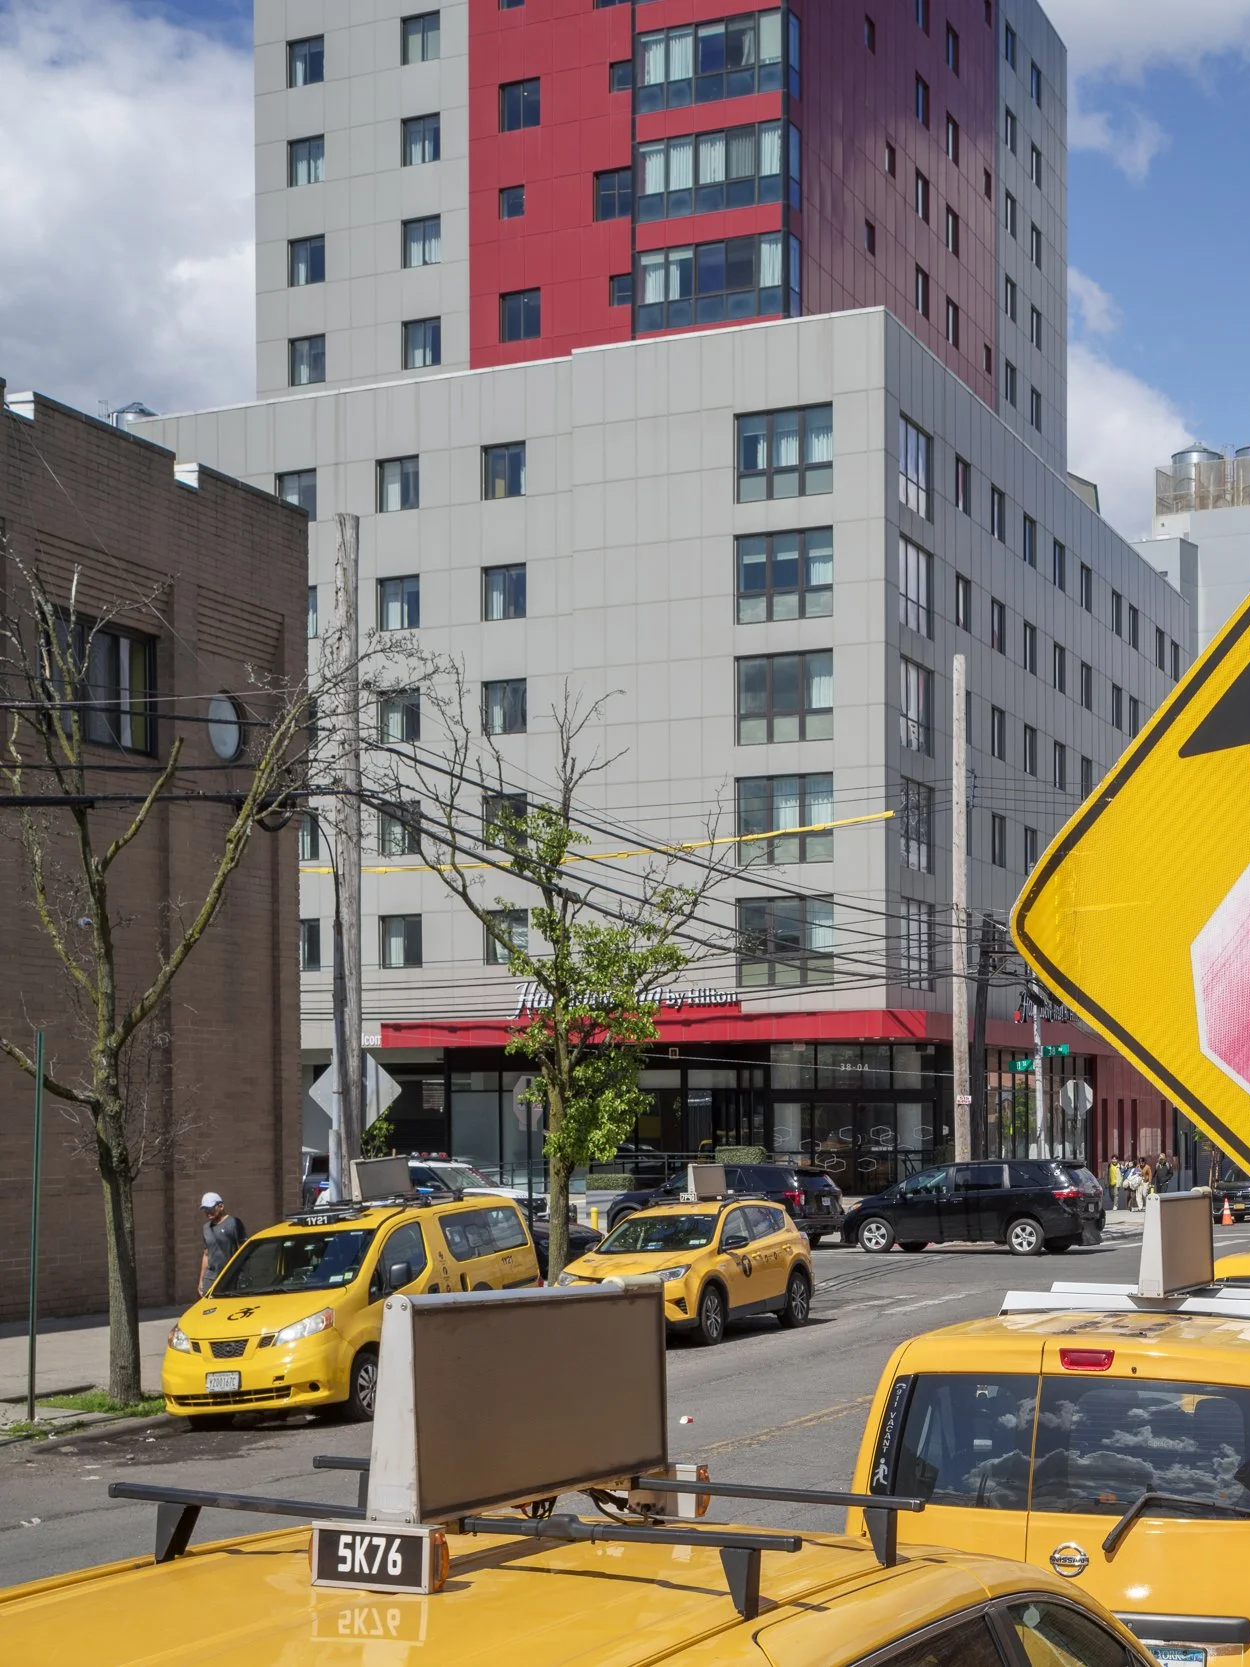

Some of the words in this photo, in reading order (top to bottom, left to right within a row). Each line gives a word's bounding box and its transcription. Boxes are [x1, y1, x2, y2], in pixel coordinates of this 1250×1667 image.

[666, 989, 684, 1008] by
[688, 988, 737, 1003] Hilton
[840, 1063, 869, 1071] 38-04
[306, 1215, 328, 1226] 1Y21
[894, 1388, 903, 1408] 911
[882, 1411, 897, 1453] VACANT
[338, 1534, 402, 1576] 5K76
